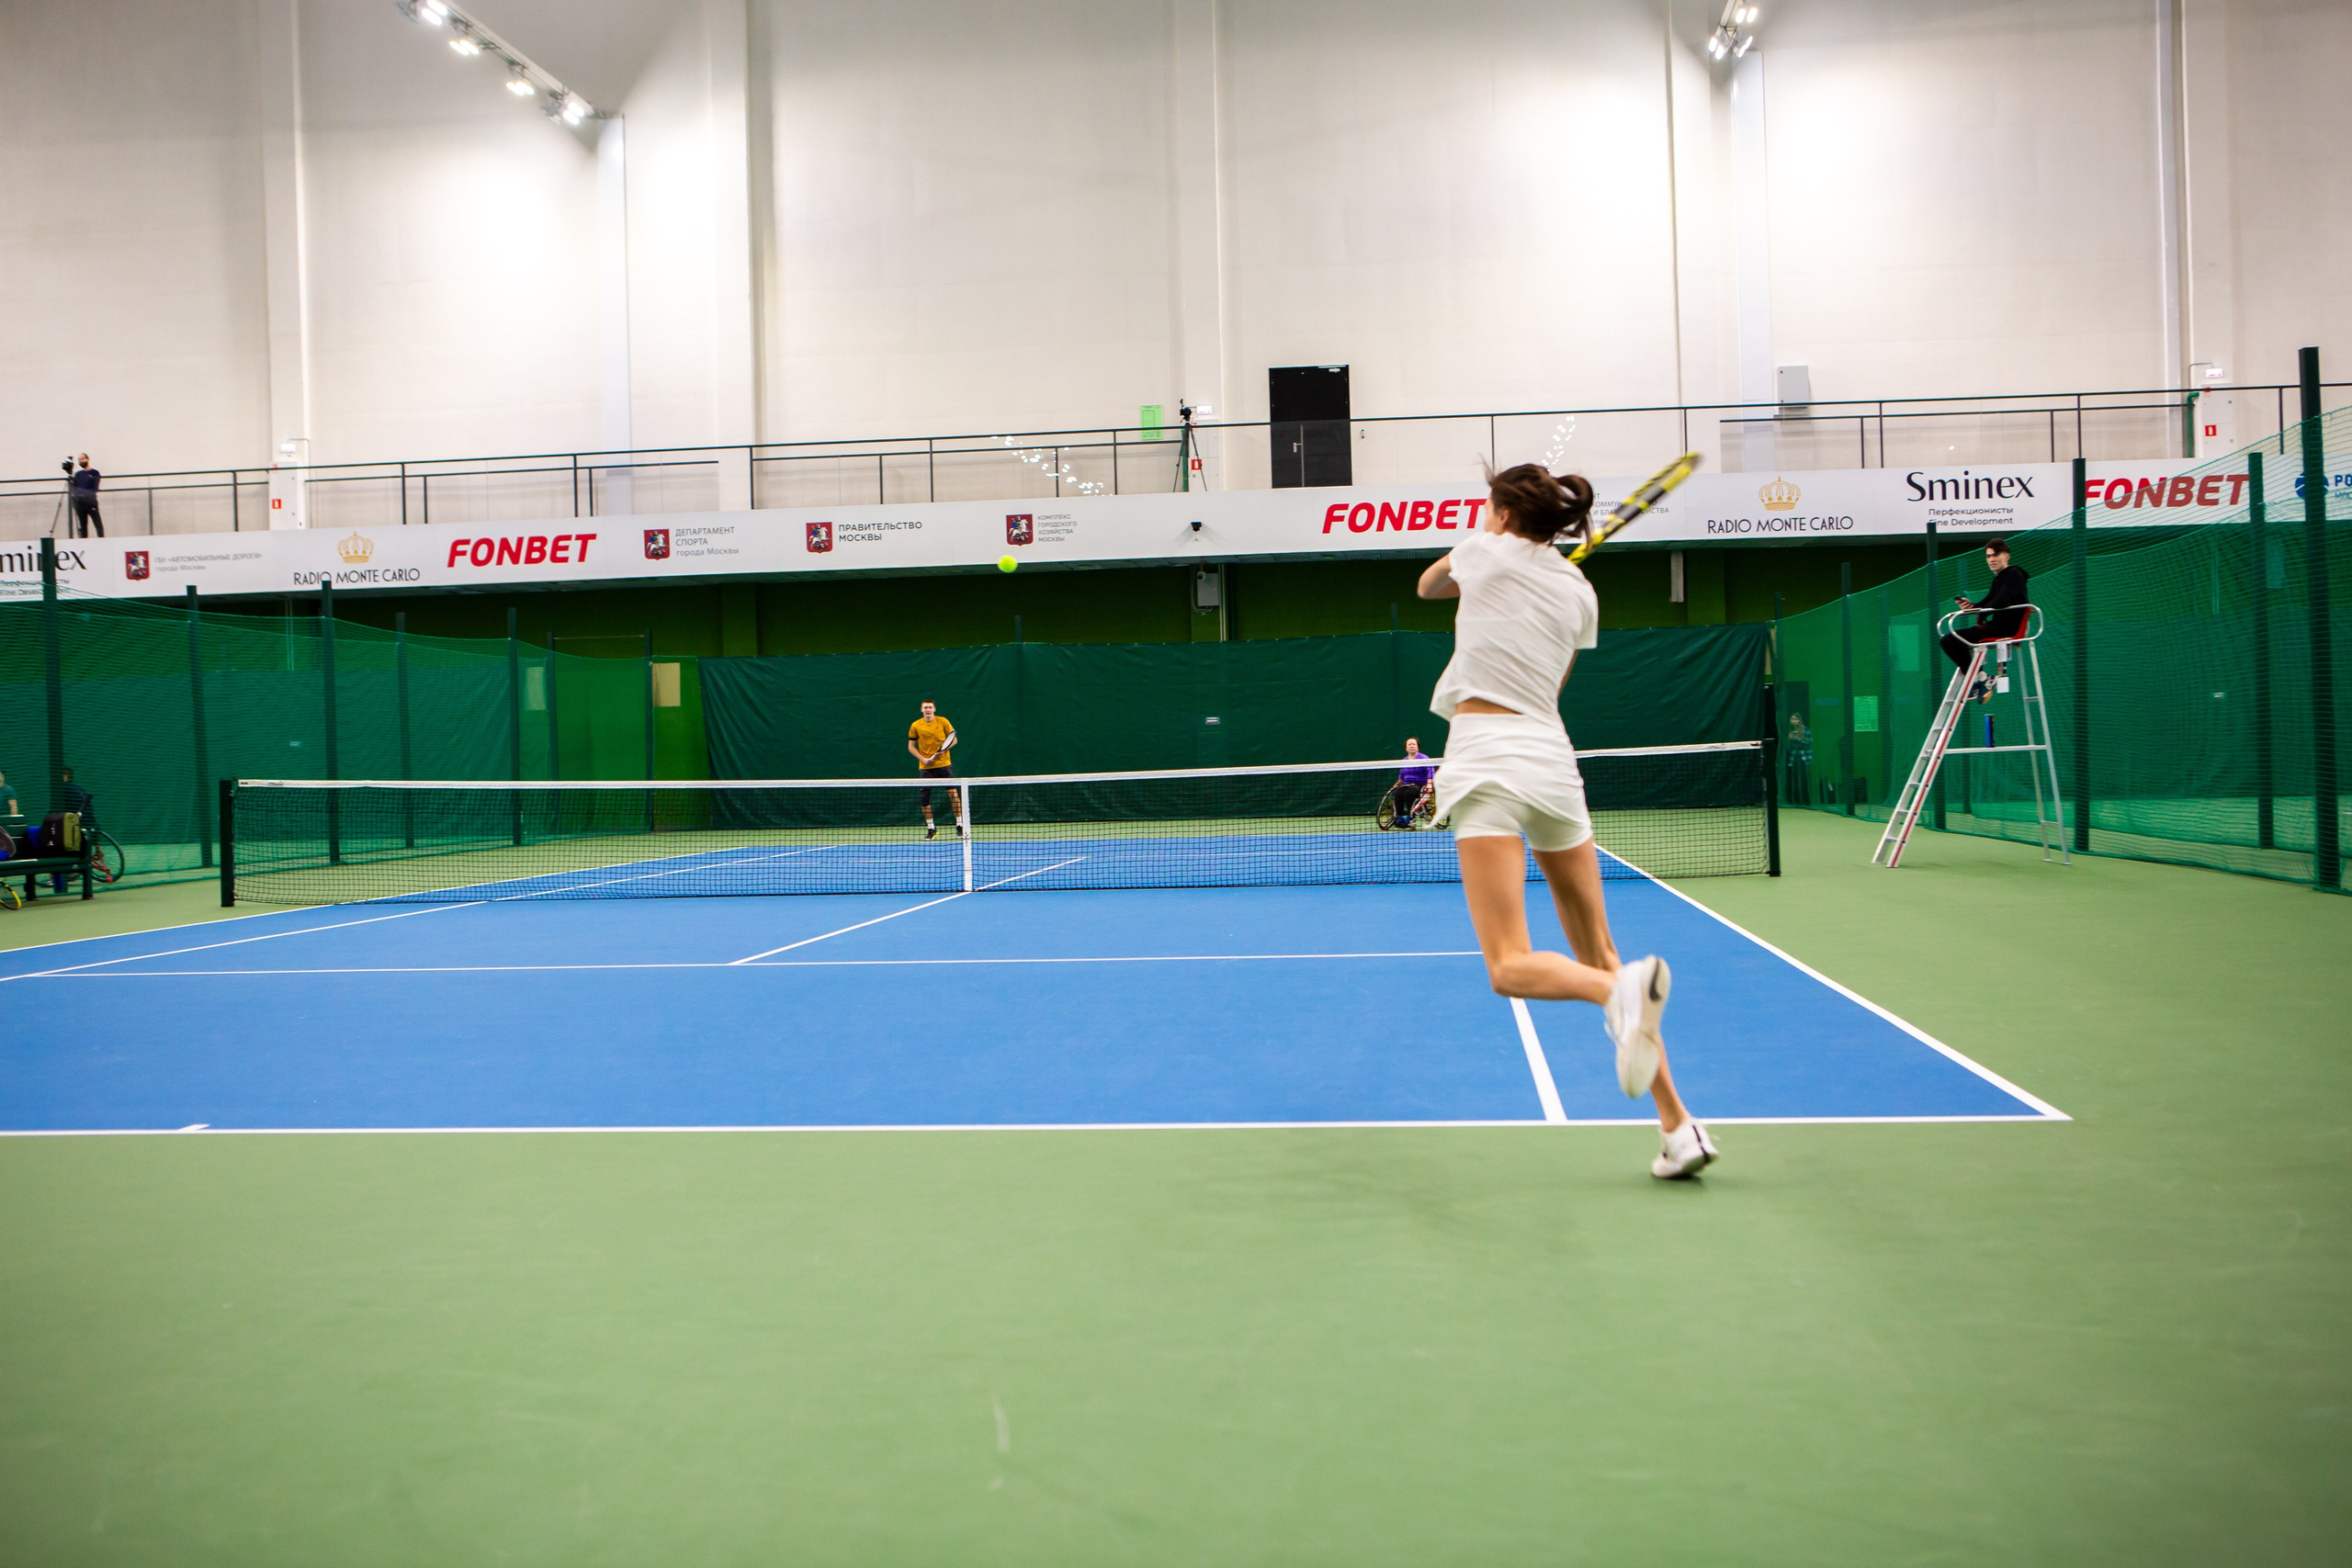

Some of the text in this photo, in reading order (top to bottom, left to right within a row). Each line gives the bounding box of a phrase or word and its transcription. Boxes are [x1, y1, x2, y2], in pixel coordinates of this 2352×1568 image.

[1905, 469, 2036, 502] Sminex
[1321, 498, 1488, 535] FONBET
[1928, 506, 2014, 517] Перфекционисты
[838, 521, 922, 532] ПРАВИТЕЛЬСТВО
[1707, 515, 1854, 534] RADIO MONTE CARLO
[1951, 516, 2014, 527] Development
[675, 526, 735, 537] ДЕПАРТАМЕНТ
[675, 537, 708, 547] СПОРТА
[839, 533, 882, 542] МОСКВЫ
[447, 533, 597, 568] FONBET
[676, 547, 740, 558] города Москвы
[0, 545, 87, 572] miex
[293, 568, 420, 585] RADIO MONTE CARLO
